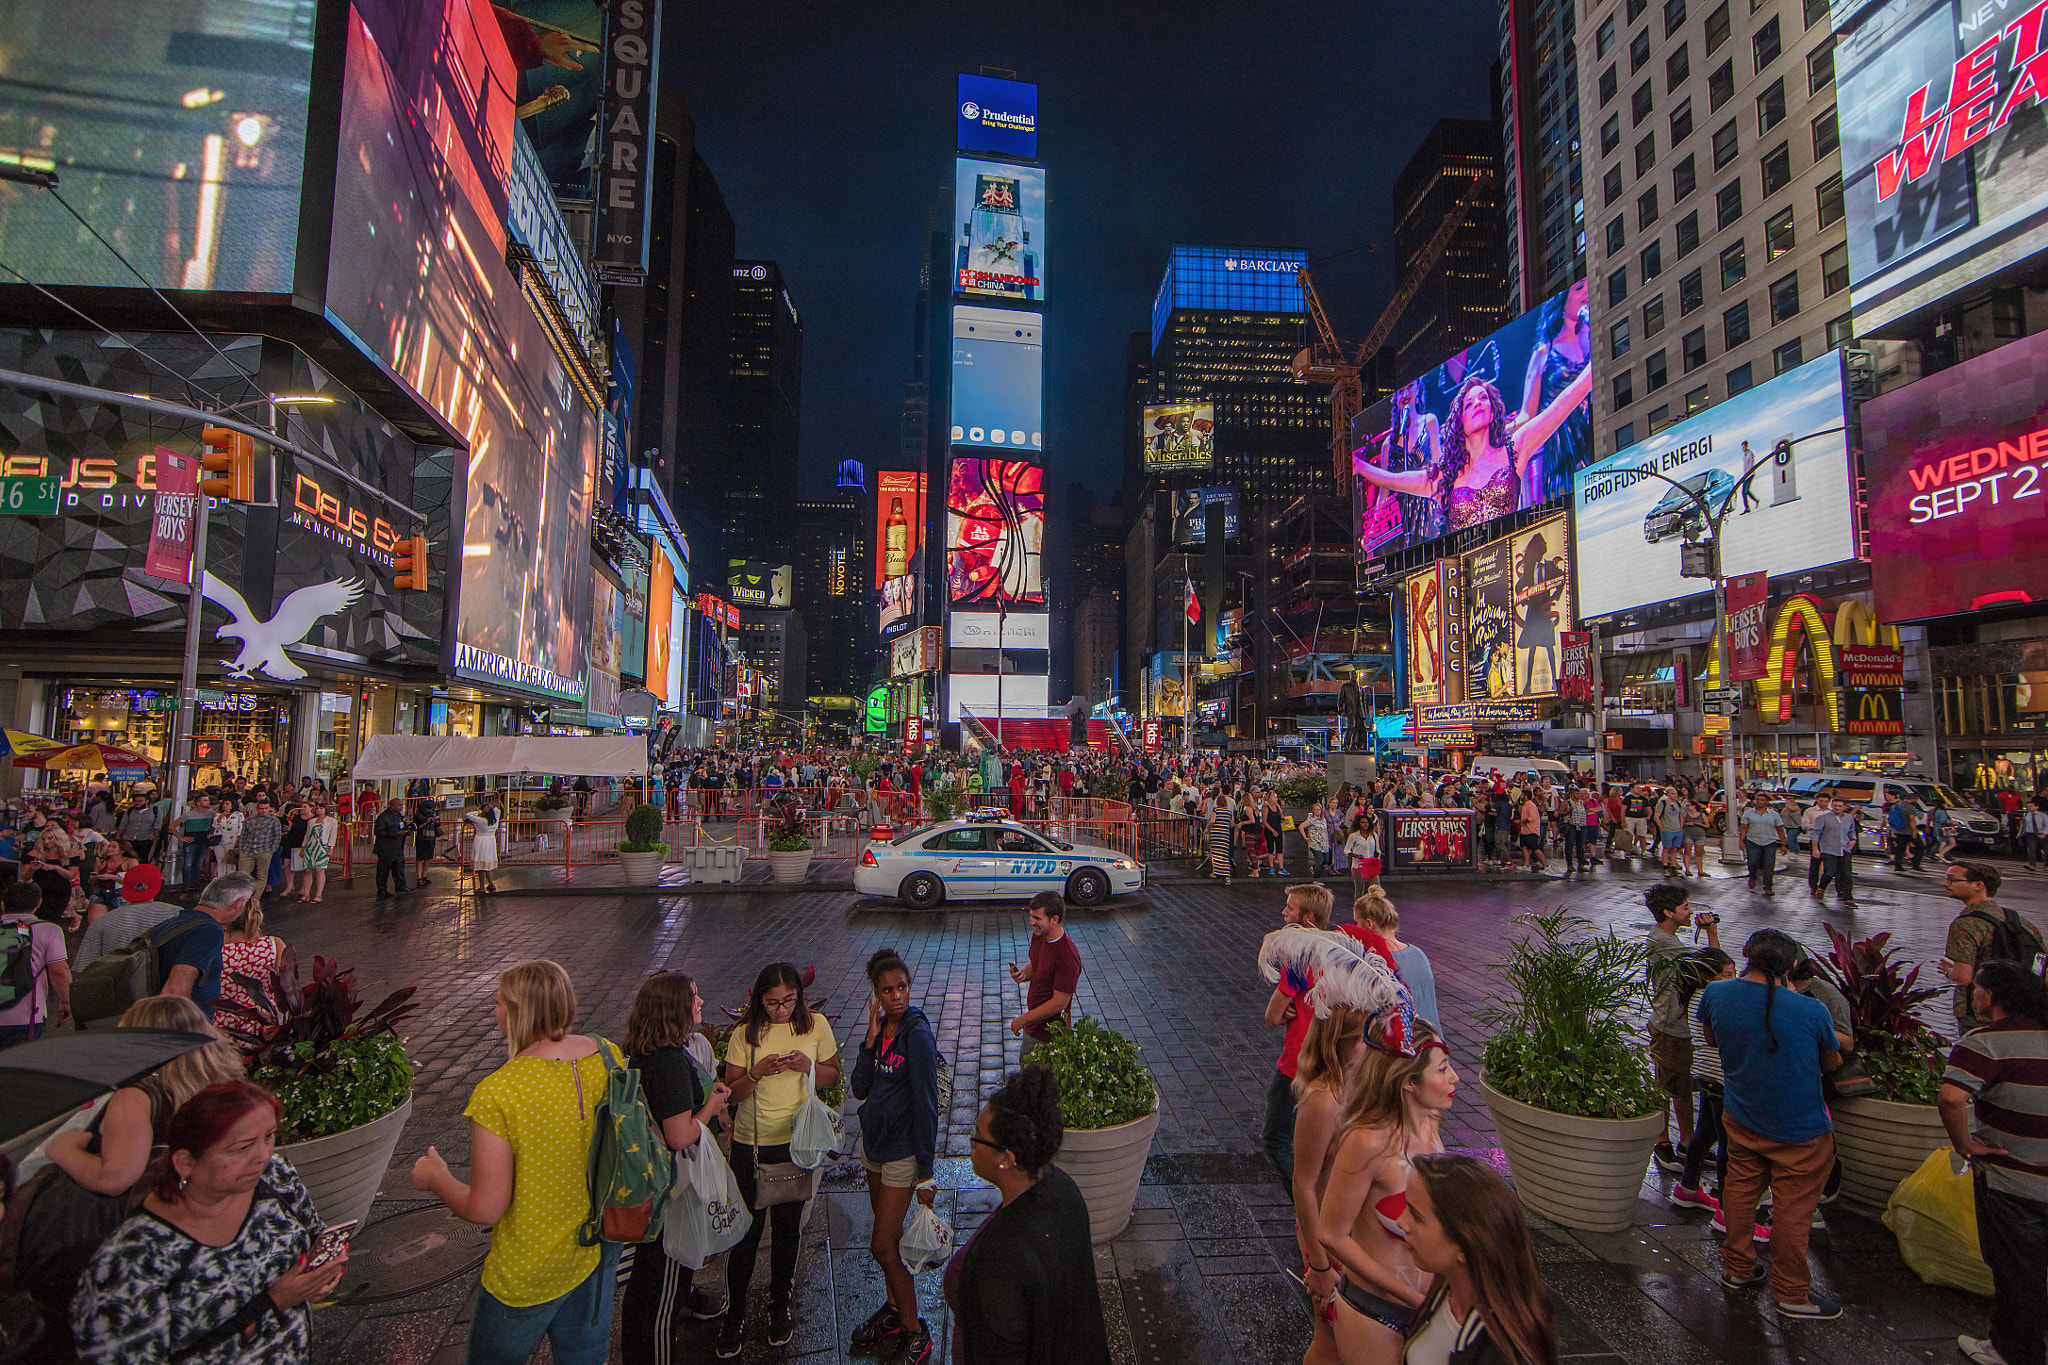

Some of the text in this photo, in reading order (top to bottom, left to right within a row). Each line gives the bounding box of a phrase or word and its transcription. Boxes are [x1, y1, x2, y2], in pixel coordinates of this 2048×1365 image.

[610, 1, 648, 209] SQUARE
[982, 108, 1035, 126] Prudential
[982, 120, 996, 128] Bring
[606, 233, 633, 245] NYC
[1240, 259, 1300, 273] BARCLAYS
[977, 271, 1039, 286] SHANDONG
[977, 281, 1005, 290] CHINA
[604, 421, 617, 486] NEW
[1169, 440, 1186, 451] Les
[1584, 434, 1713, 504] FORD FUSION ENERGI
[38, 481, 55, 500] St
[1909, 472, 2008, 524] SEPT
[155, 494, 195, 519] JERSEY
[294, 472, 368, 540] DEUS
[156, 515, 187, 542] BOYS
[1364, 511, 1403, 545] FEET!
[292, 511, 395, 568] MANKIND DIVIDE
[835, 546, 846, 596] NOVOTEL
[731, 585, 766, 600] WICKED
[885, 622, 908, 634] INGLOT
[1447, 567, 1462, 673] PALACE
[1730, 604, 1766, 633] JERSEY
[926, 628, 937, 669] HELLO!
[1734, 626, 1760, 651] BOYS
[1562, 644, 1590, 662] JERSEY
[1843, 653, 1902, 663] McDonald's
[457, 644, 520, 682] AMERICAN
[520, 662, 546, 689] EAGLE
[1565, 660, 1586, 675] BOYS
[149, 699, 158, 708] W
[160, 699, 171, 708] 46
[908, 719, 920, 741] tkts
[1147, 722, 1159, 745] tkts
[1496, 723, 1517, 731] CHANGE
[1517, 722, 1536, 730] MONEY
[1397, 820, 1467, 838] JERSEY BOYS
[1010, 860, 1057, 874] NYPD
